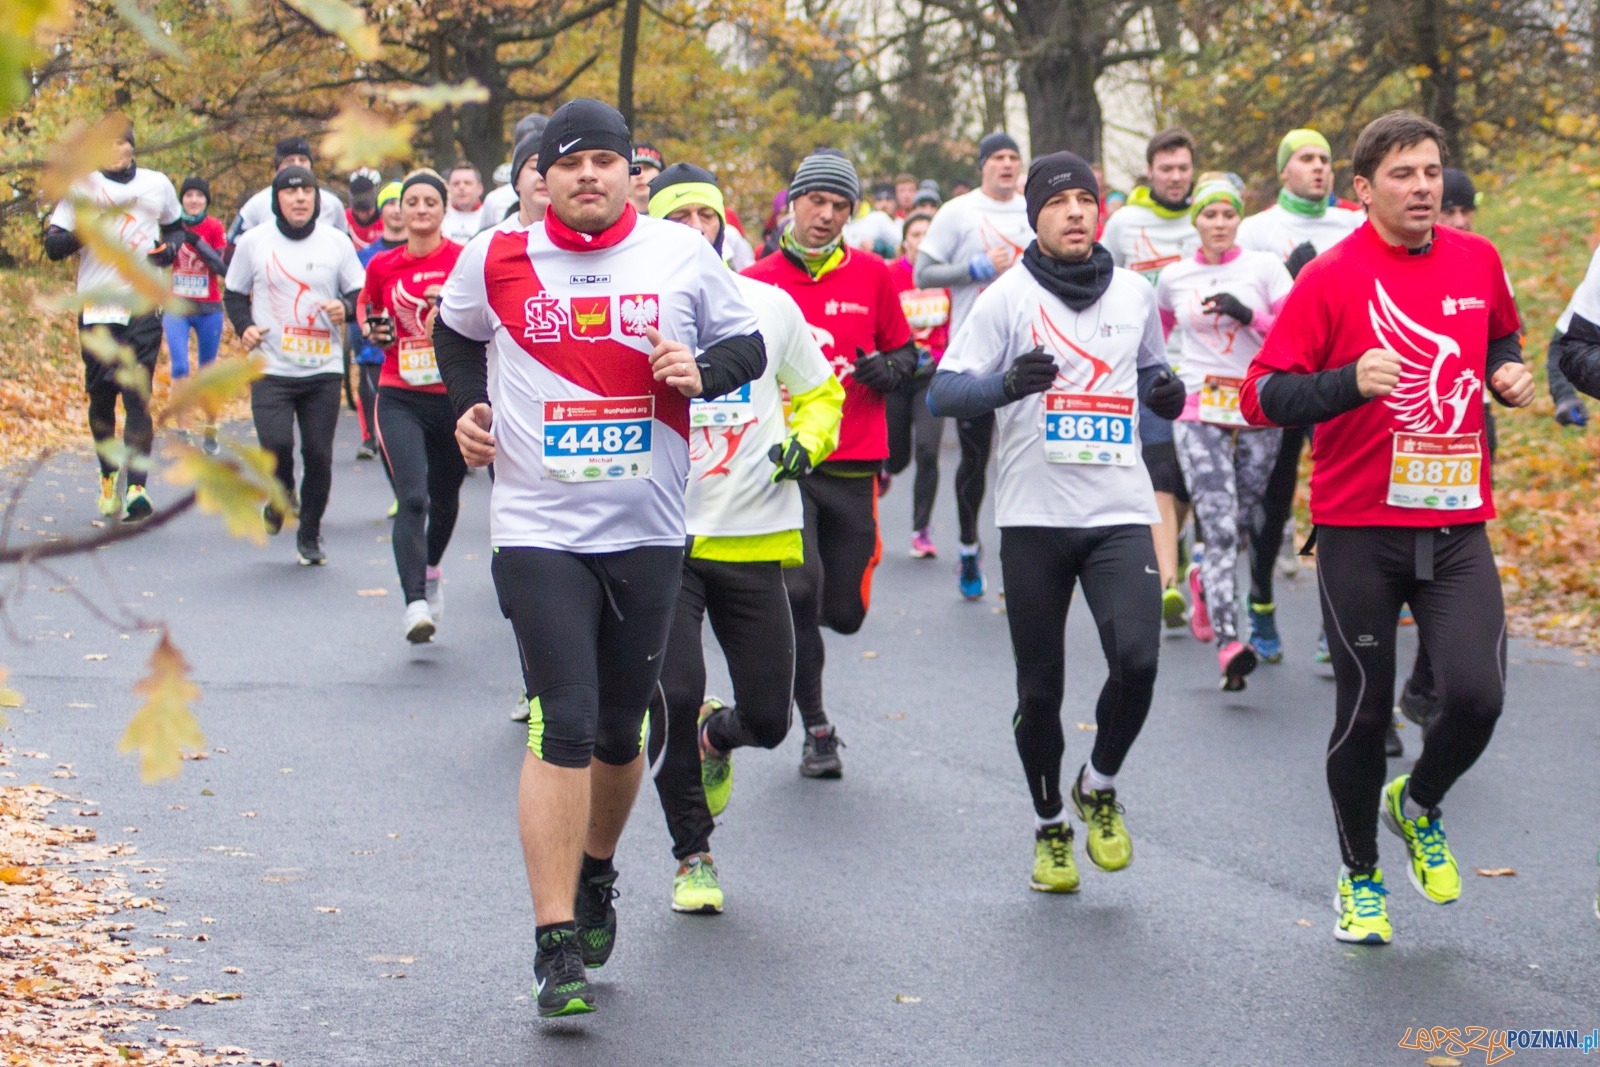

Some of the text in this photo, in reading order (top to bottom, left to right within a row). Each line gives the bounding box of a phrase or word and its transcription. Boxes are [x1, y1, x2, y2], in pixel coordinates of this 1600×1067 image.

[603, 407, 647, 415] RunPoland.org
[546, 425, 643, 453] E 4482
[1057, 416, 1125, 442] 8619
[1406, 459, 1473, 484] 8878
